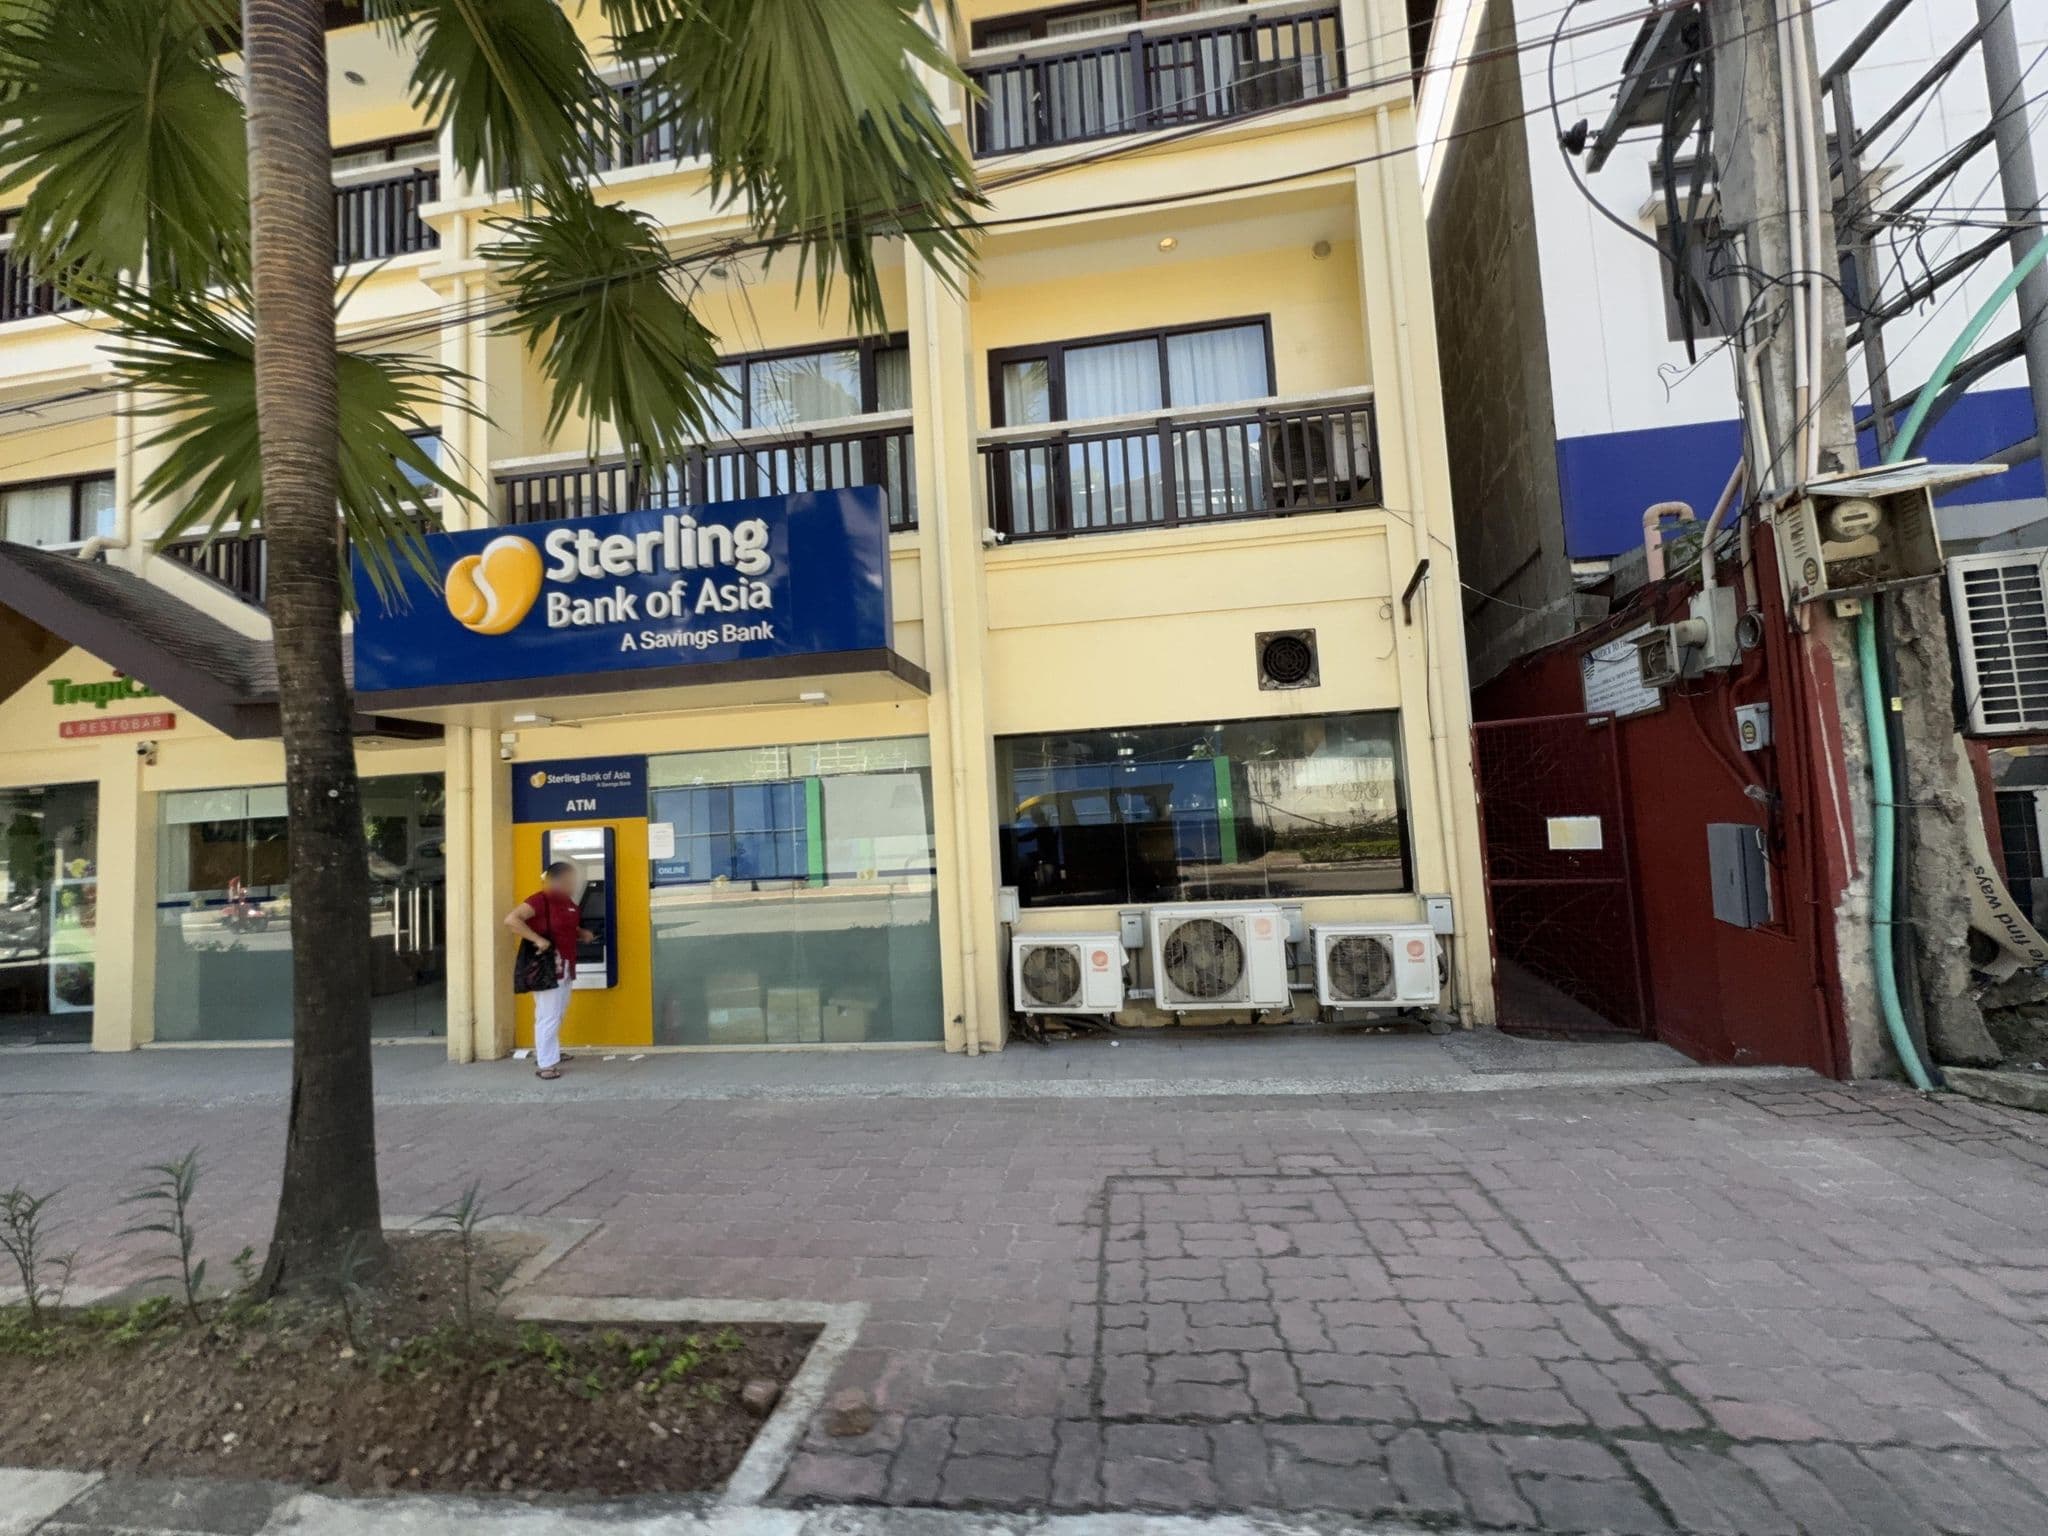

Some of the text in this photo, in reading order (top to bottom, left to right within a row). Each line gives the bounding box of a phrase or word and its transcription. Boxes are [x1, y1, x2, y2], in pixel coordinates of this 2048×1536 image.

[545, 514, 772, 583] Sterling
[547, 576, 773, 628] Bank of Asia
[621, 620, 775, 652] A Savings Bank
[79, 716, 161, 732] RESTOBAR
[547, 770, 631, 784] Sterling Bank of Asia
[566, 798, 597, 812] ATM
[1973, 865, 2003, 910] ways
[1993, 913, 2032, 945] find
